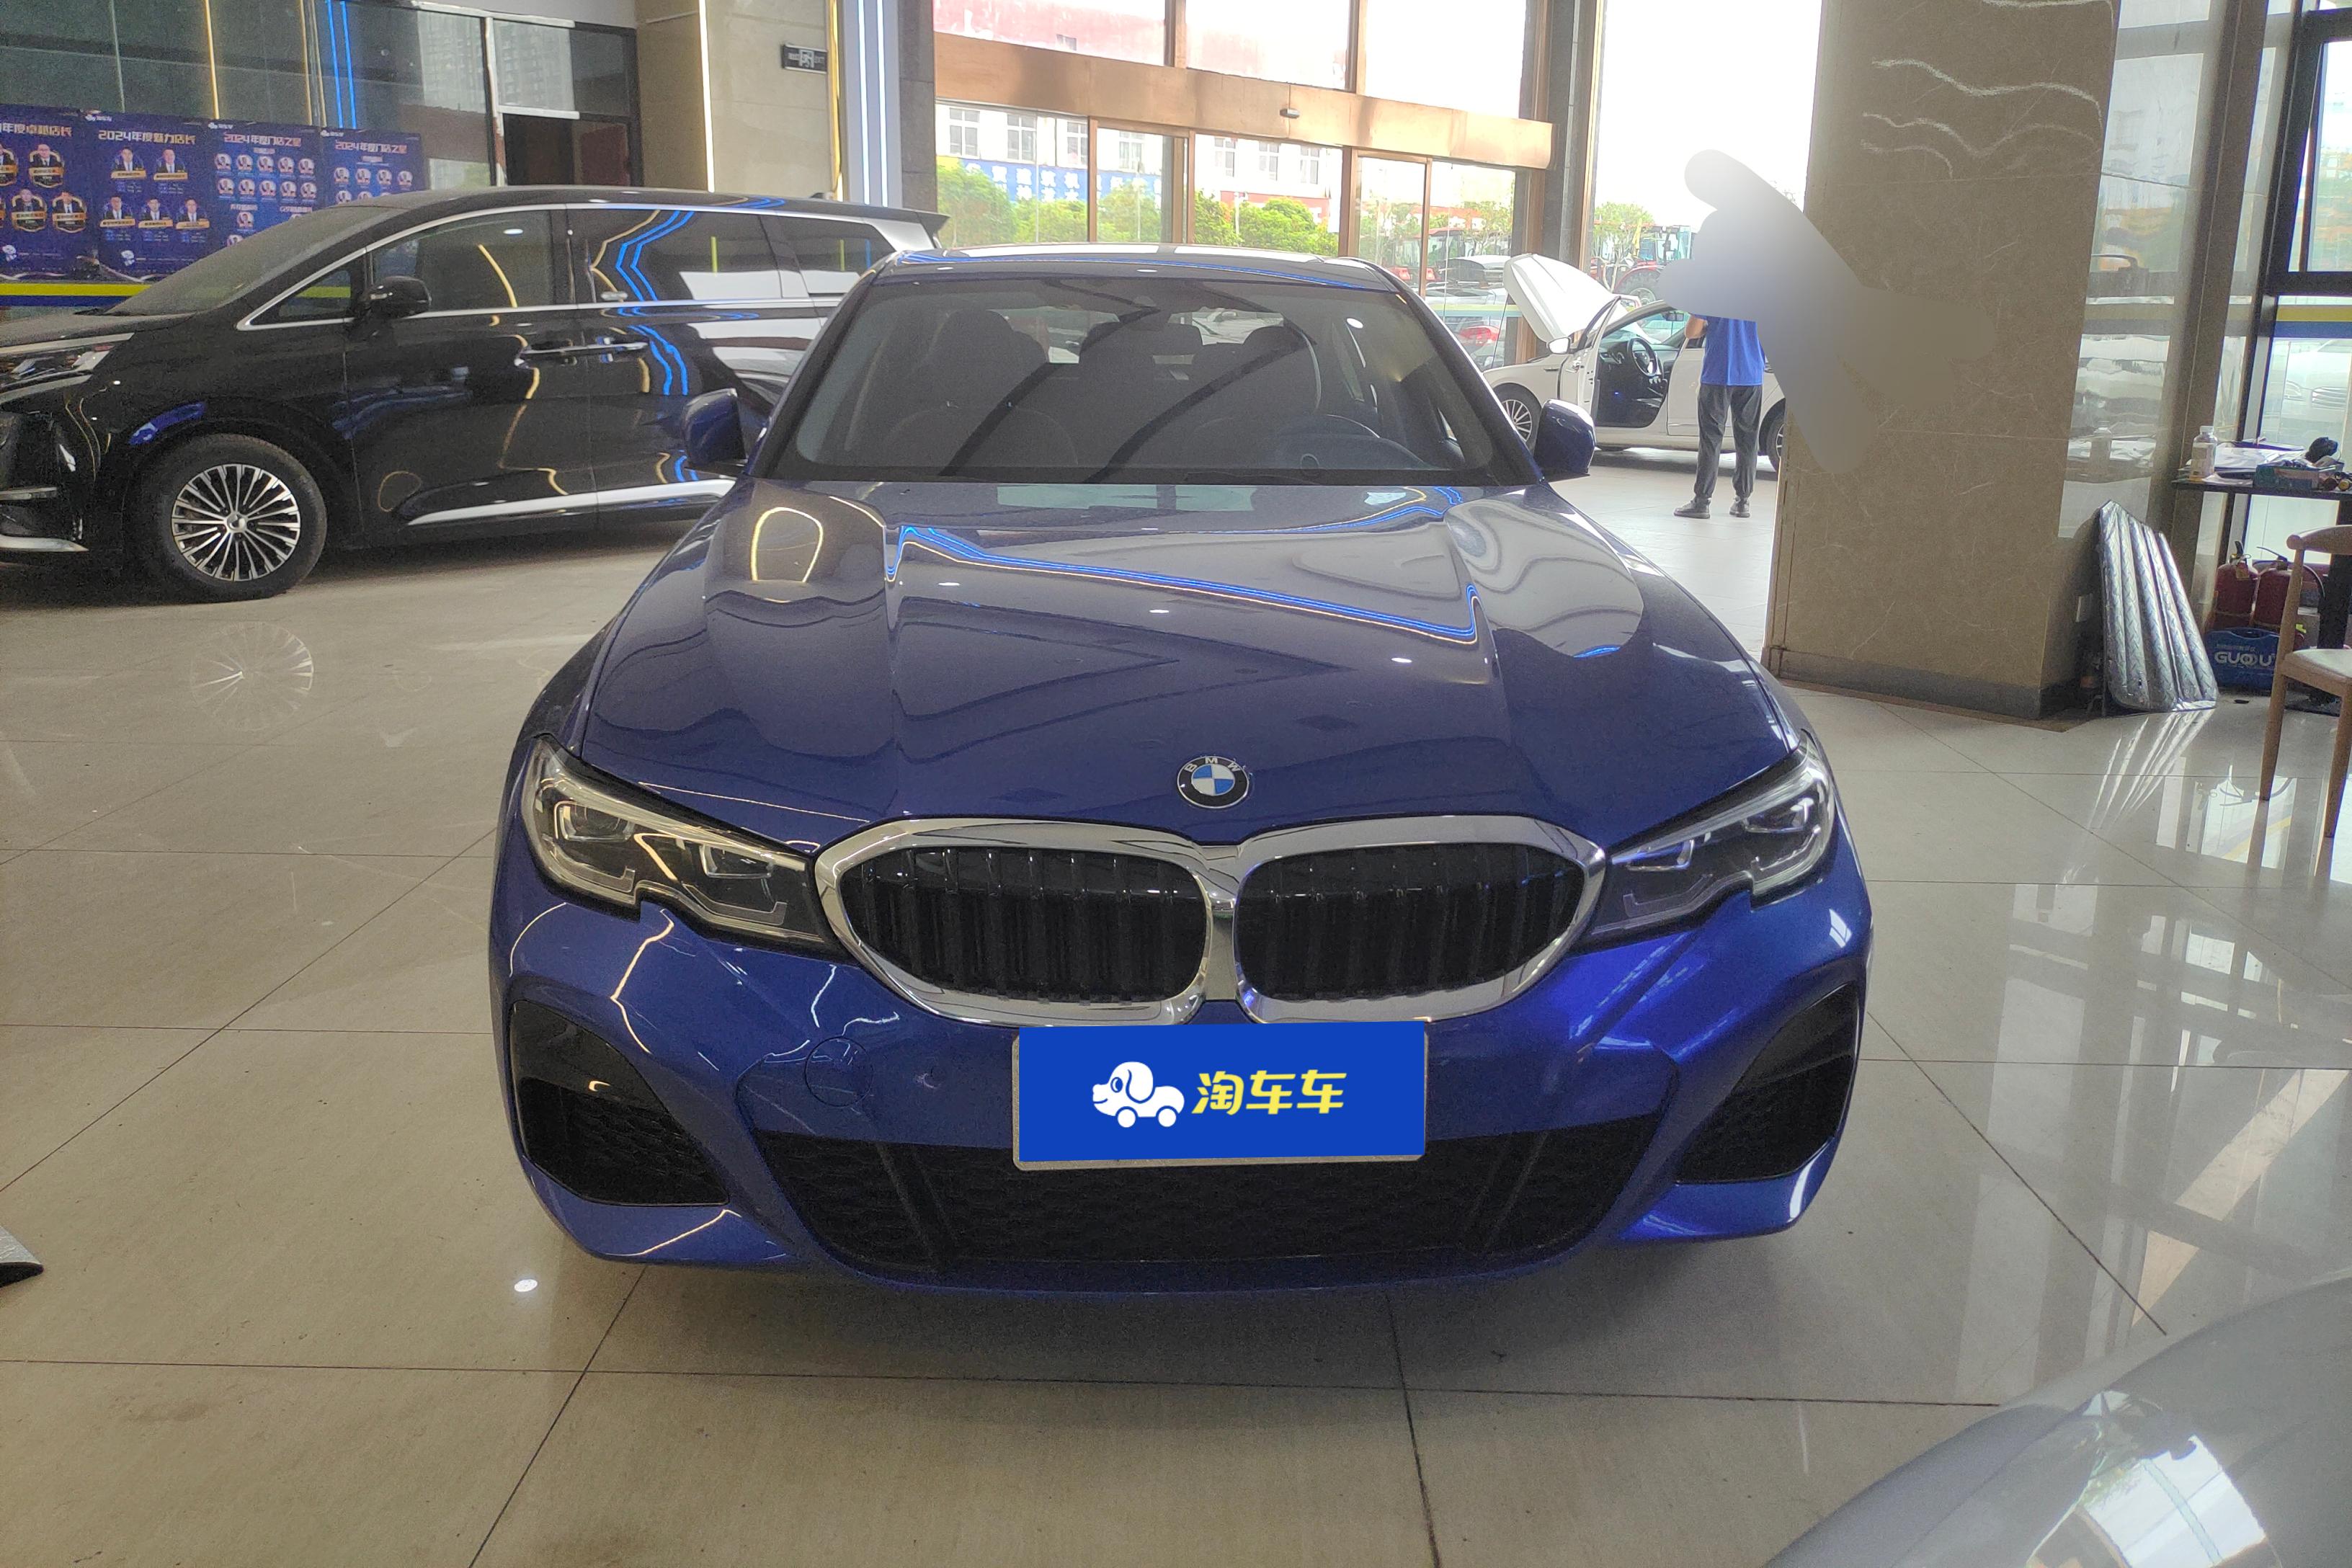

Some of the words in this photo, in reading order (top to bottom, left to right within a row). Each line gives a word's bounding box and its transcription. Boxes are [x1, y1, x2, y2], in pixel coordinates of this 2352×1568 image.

[0, 122, 73, 137] 年度卓越店长
[98, 130, 196, 145] 2024年度魅力店长
[1184, 757, 1241, 772] BMW
